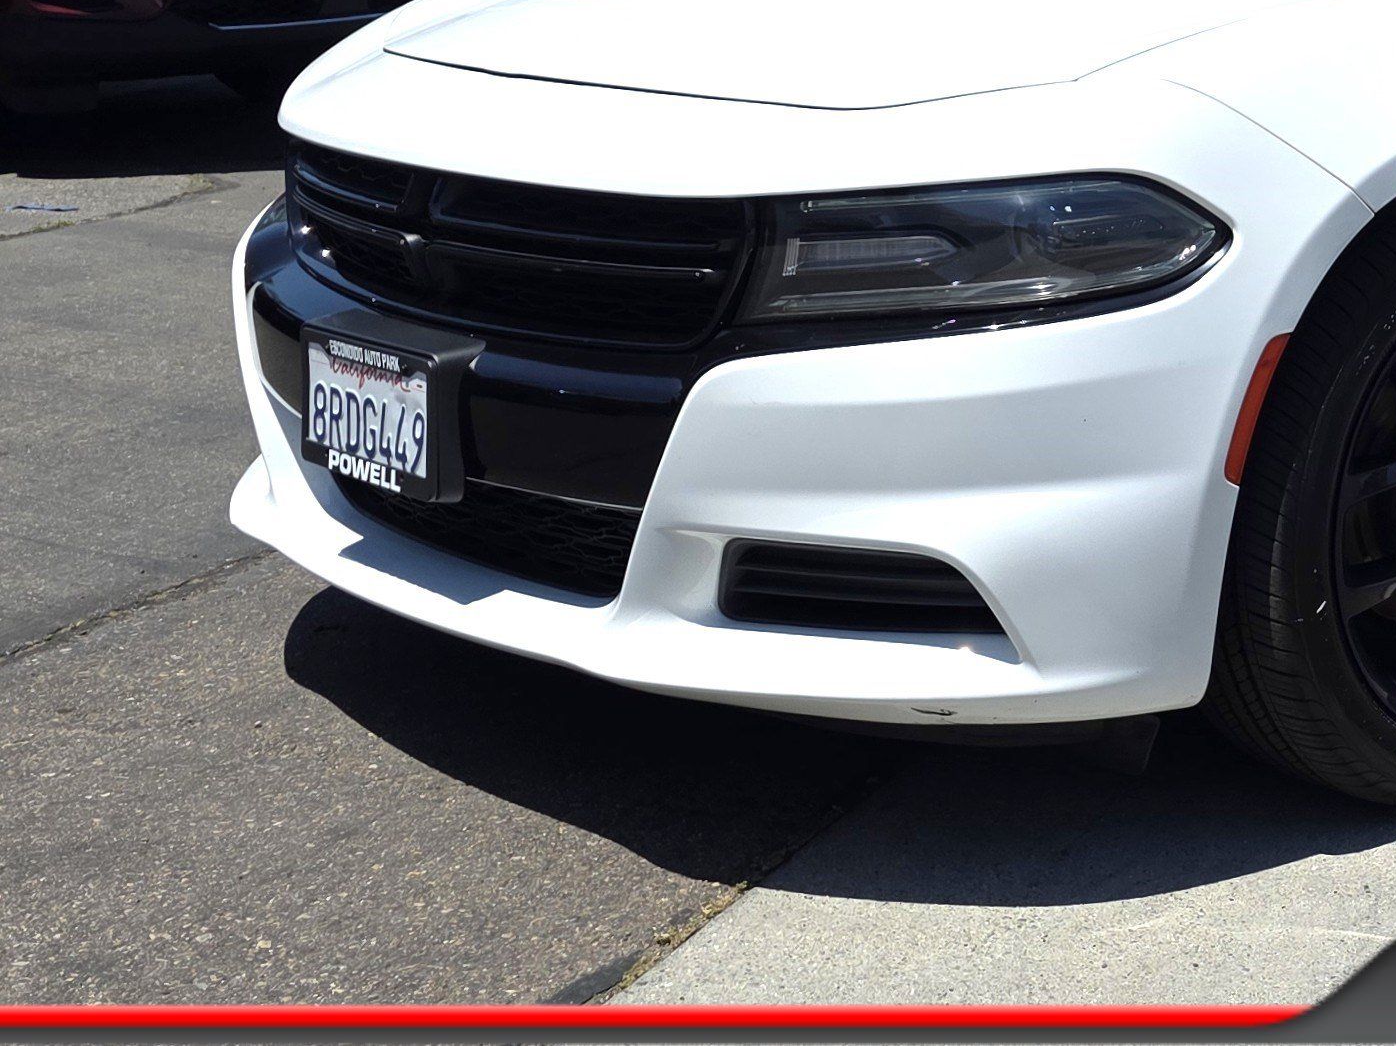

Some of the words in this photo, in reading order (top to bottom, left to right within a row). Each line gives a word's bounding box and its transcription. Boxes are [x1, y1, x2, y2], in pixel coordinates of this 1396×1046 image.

[328, 339, 364, 364] ESCONDIDO
[364, 348, 382, 368] AUTO
[381, 353, 401, 373] PARK
[313, 381, 426, 474] 8RDG449
[328, 449, 402, 493] POWELL
